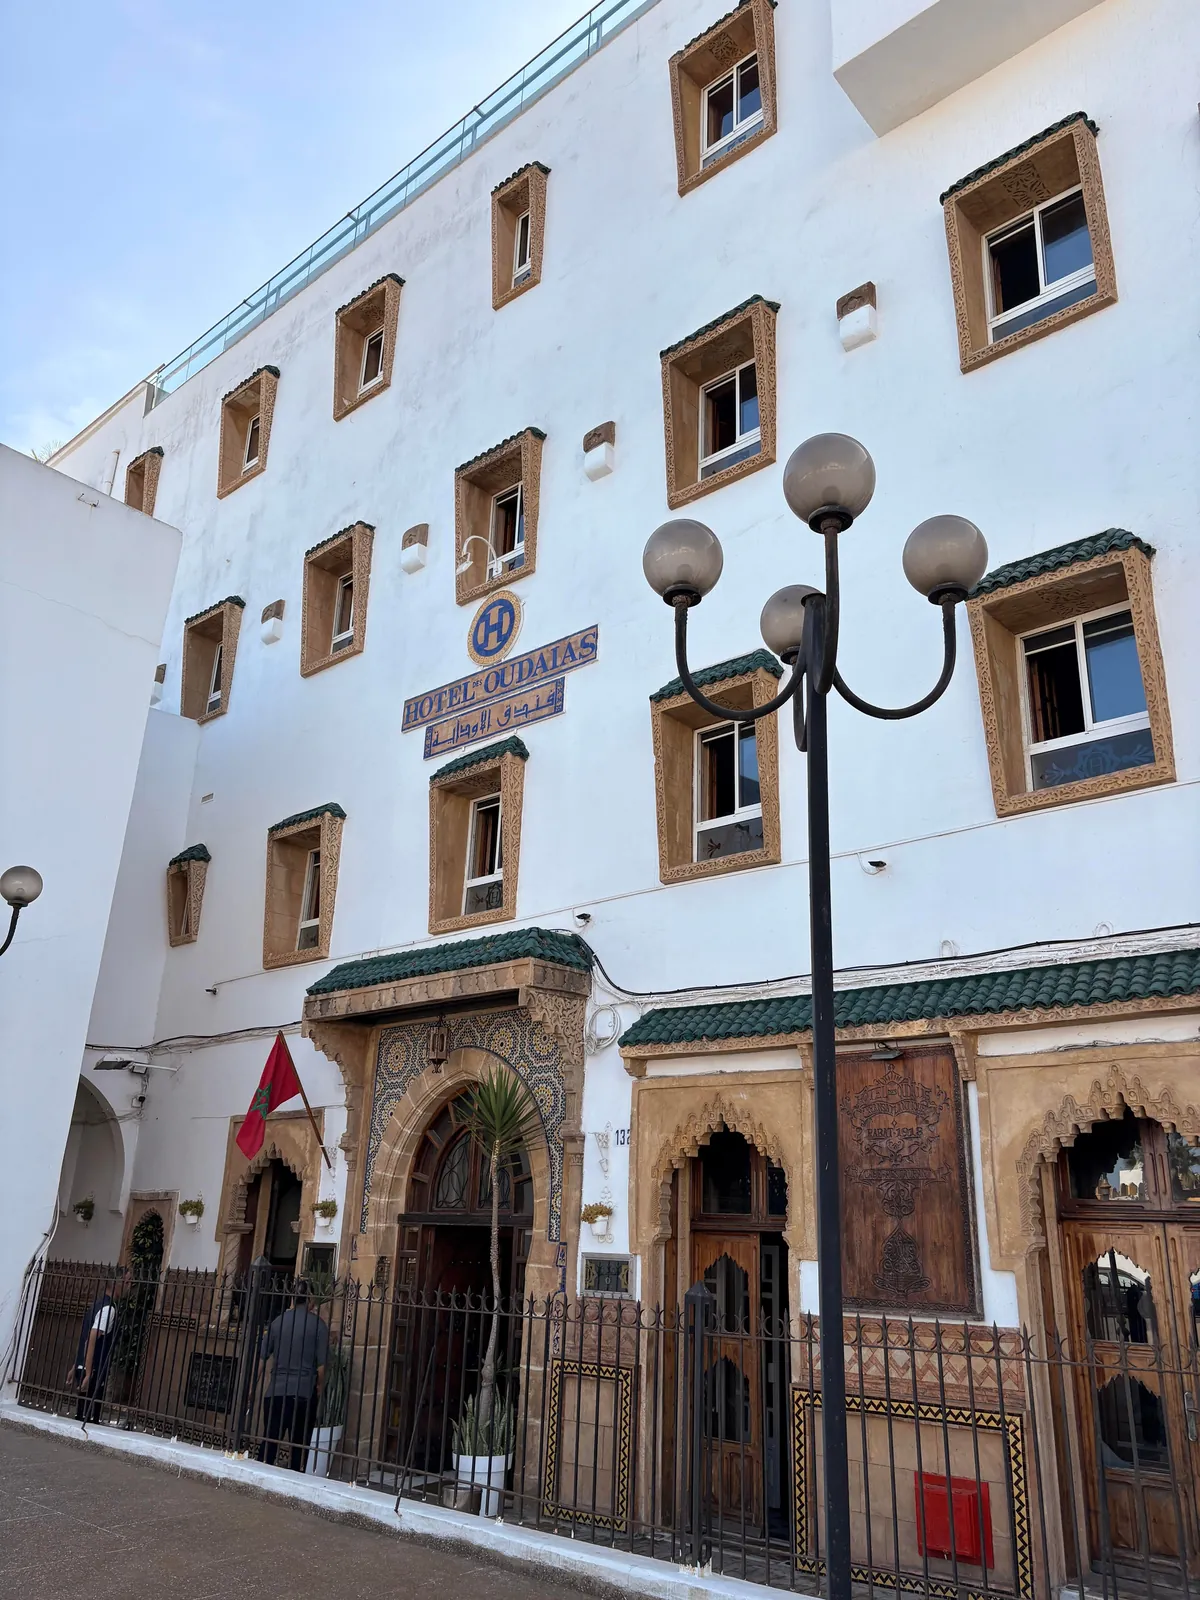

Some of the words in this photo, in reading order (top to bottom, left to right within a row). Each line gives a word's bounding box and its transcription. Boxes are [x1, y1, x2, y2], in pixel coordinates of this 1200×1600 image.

[403, 681, 476, 726] HOTEL
[472, 679, 483, 689] DES
[484, 631, 596, 694] OUDAIAS
[497, 690, 555, 727] فندق
